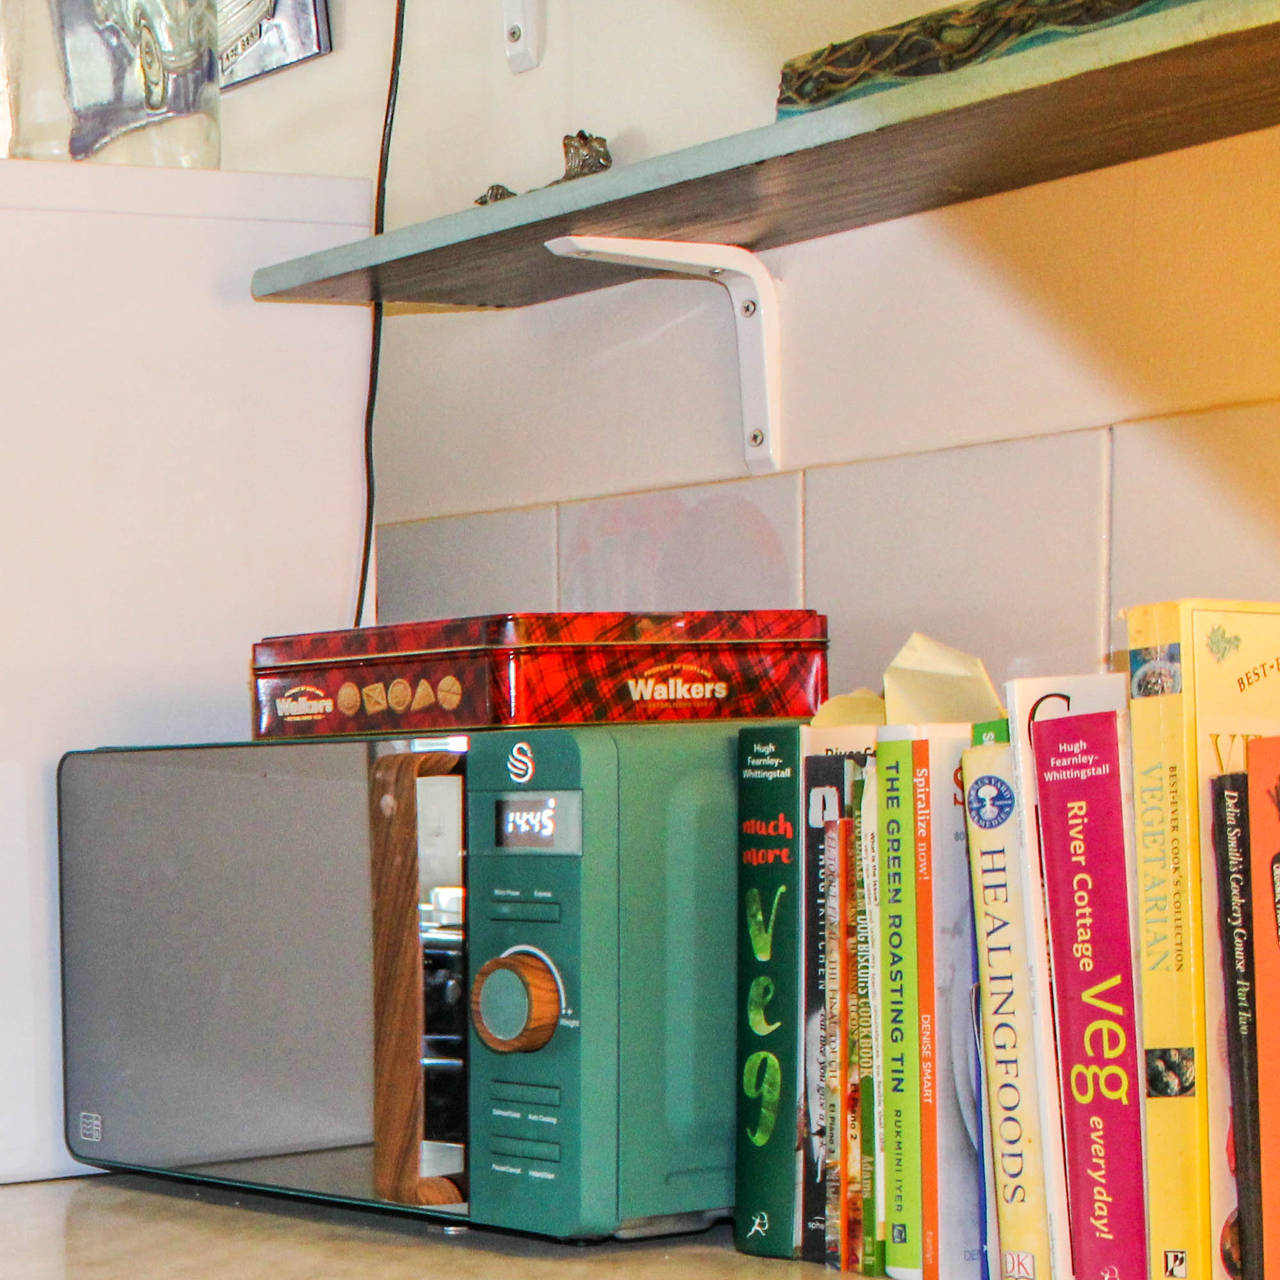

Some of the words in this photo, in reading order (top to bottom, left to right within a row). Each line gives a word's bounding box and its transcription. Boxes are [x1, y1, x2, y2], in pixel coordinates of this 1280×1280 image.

[627, 678, 728, 701] Walkers
[1237, 656, 1280, 693] BEST-E
[753, 743, 776, 756] Hugh
[1050, 754, 1099, 768] Fearnley-
[1058, 740, 1087, 754] Hugh
[742, 768, 791, 780] Whittingstall
[885, 761, 900, 808] THE
[1043, 764, 1110, 782] Whittingstall
[913, 768, 930, 837] Spiralize
[1168, 765, 1179, 833] BEST-EVER
[1225, 789, 1239, 825] Delia
[743, 813, 793, 839] much
[1067, 801, 1088, 866] River
[743, 848, 792, 866] more
[886, 819, 902, 904] GREEN
[918, 842, 930, 881] now!
[1140, 762, 1171, 972] VEGETARIAN
[1171, 838, 1182, 886] COOK'S
[1227, 827, 1243, 872] Smith's
[1227, 874, 1245, 926] Cookery
[857, 915, 868, 942] DOG
[1072, 873, 1094, 972] Cottage
[1173, 892, 1183, 973] COLLECTION
[1233, 928, 1248, 973] Course
[888, 914, 904, 1043] ROASTING
[1236, 980, 1251, 1008] Part
[858, 999, 873, 1079] COOKBOOK
[921, 1014, 932, 1057] DENISE
[1238, 1009, 1252, 1036] Two
[891, 1053, 904, 1093] TIN
[922, 1062, 933, 1104] SMART
[894, 1109, 903, 1172] RUKMINI
[862, 1155, 874, 1199] Adams
[895, 1179, 903, 1213] IYER
